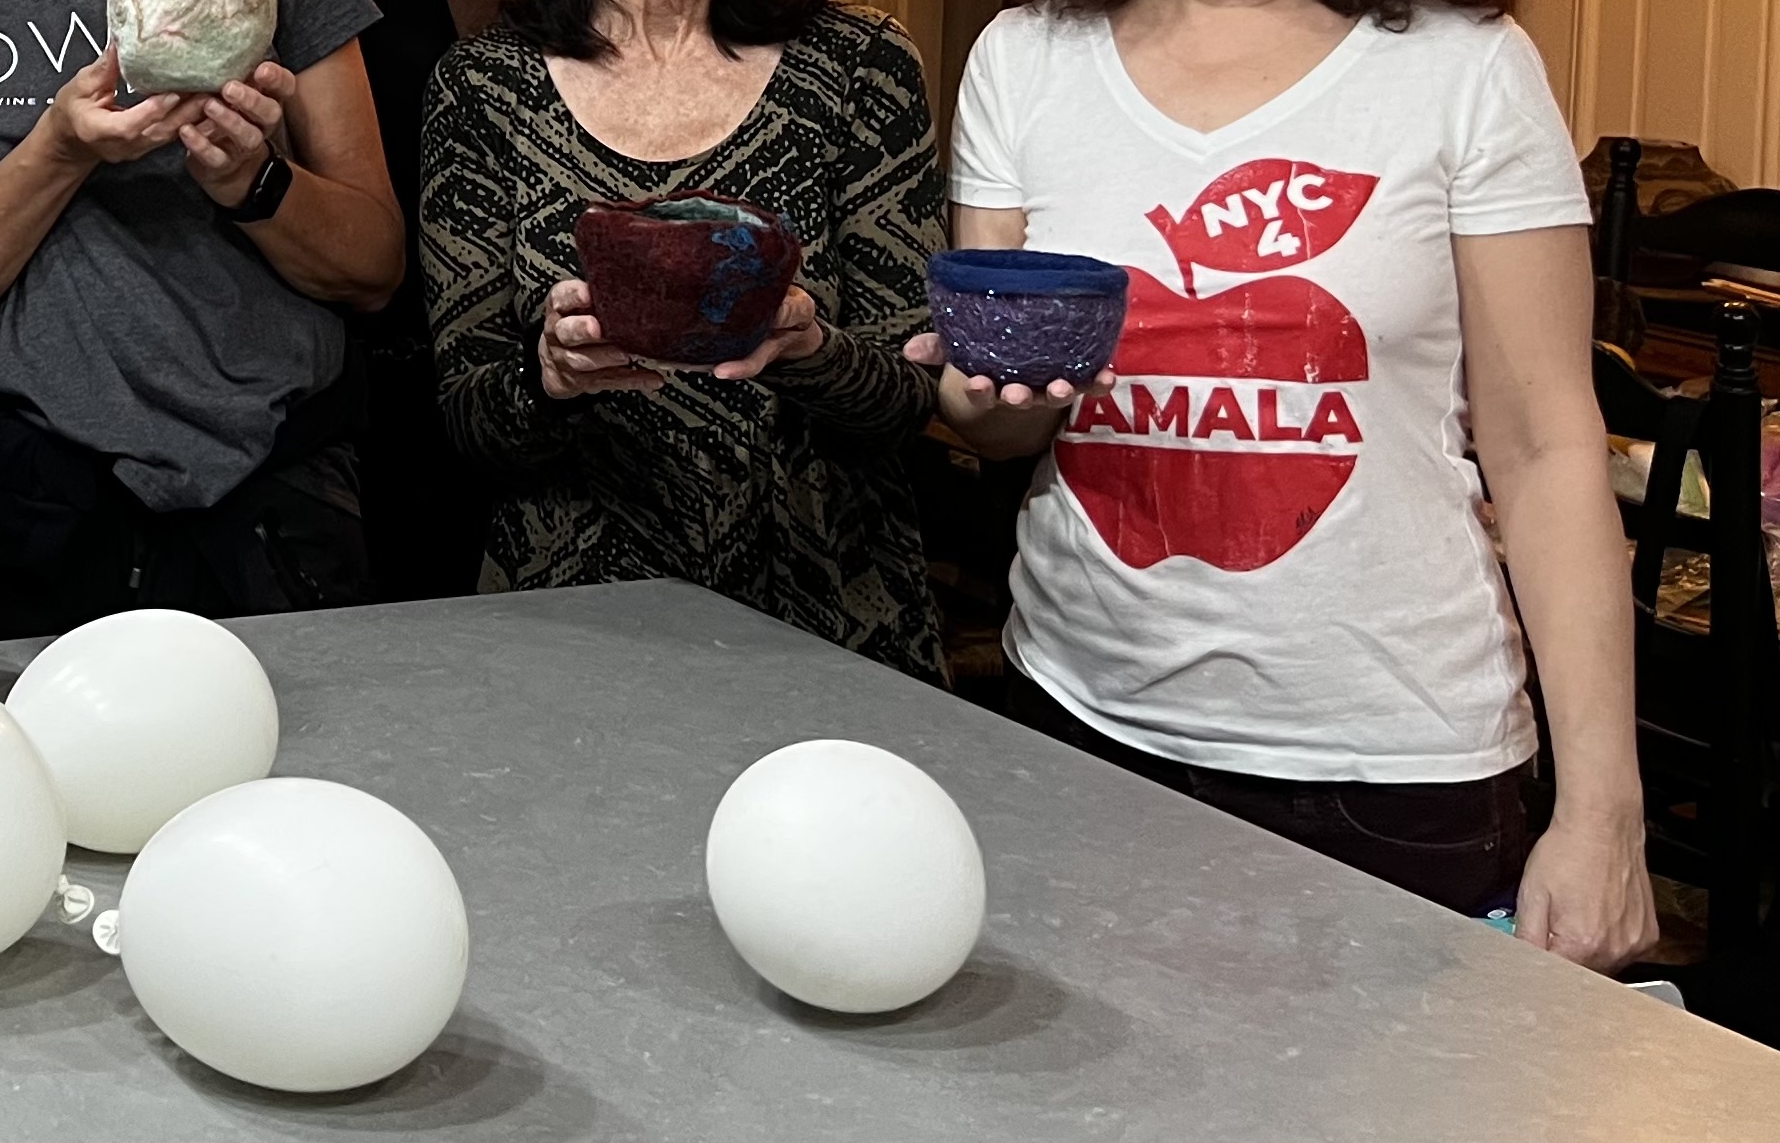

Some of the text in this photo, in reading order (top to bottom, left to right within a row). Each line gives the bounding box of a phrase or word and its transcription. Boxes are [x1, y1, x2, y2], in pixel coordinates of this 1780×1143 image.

[1200, 173, 1334, 238] NYC
[1257, 218, 1301, 258] 4
[1066, 384, 1364, 443] AMALA
